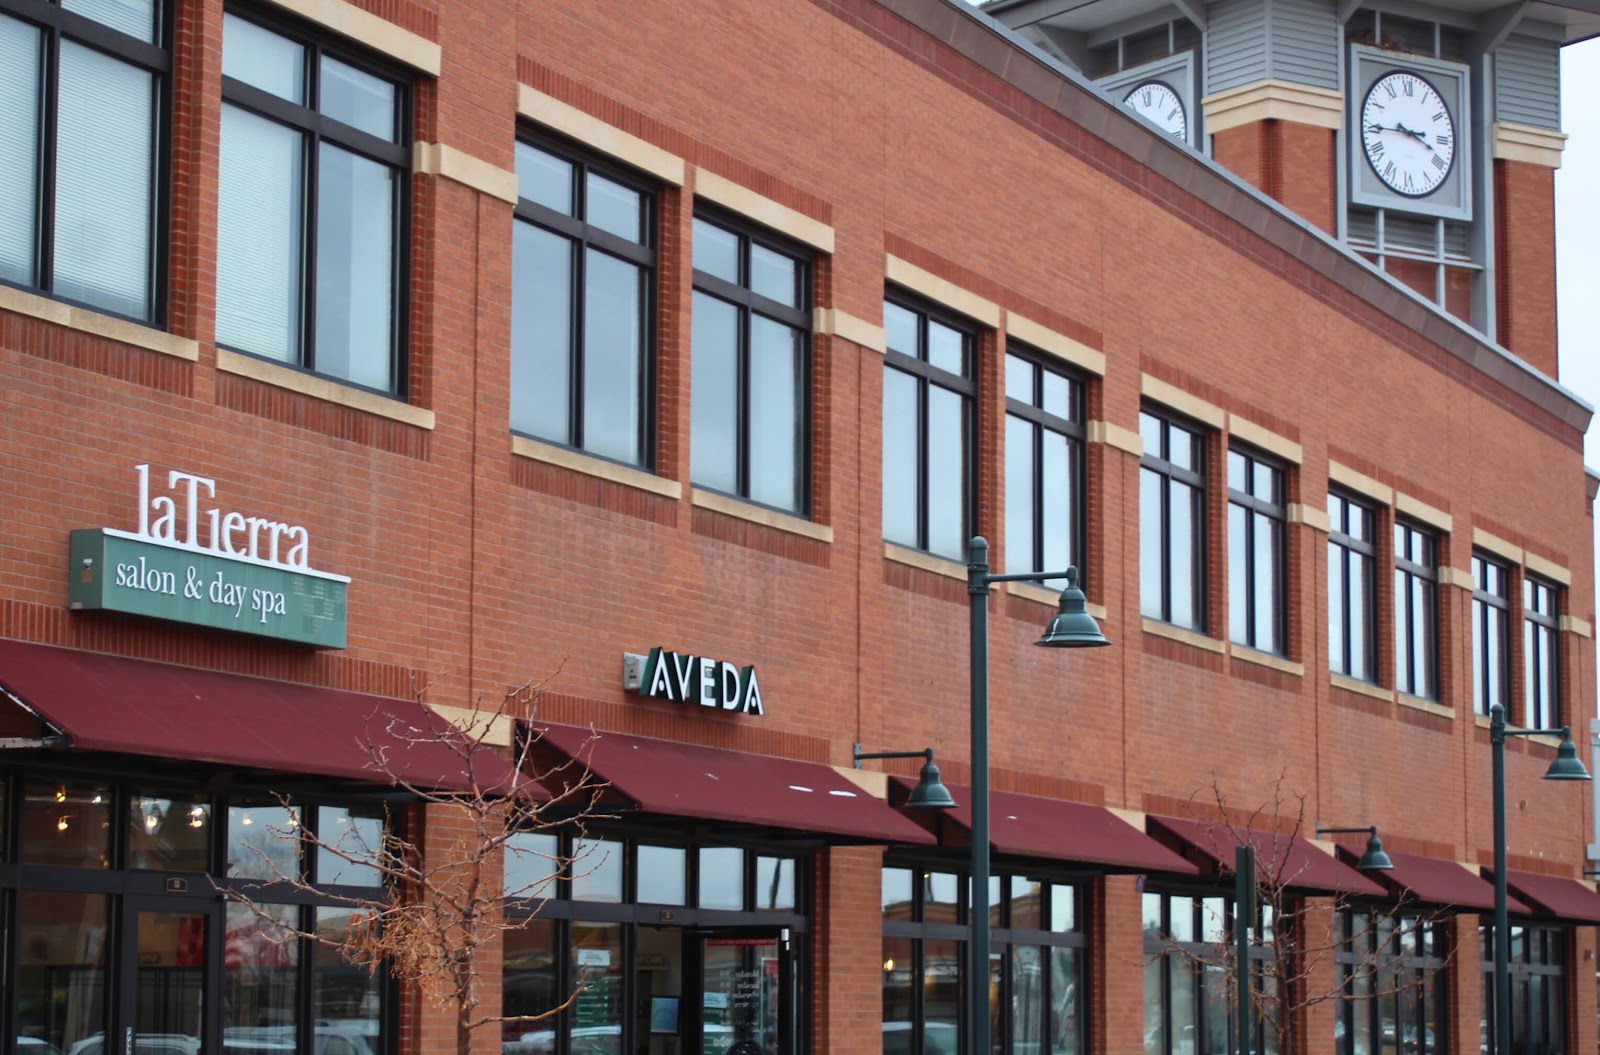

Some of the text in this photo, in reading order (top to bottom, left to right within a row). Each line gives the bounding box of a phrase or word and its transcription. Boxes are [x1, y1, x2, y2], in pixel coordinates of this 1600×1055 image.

[115, 556, 287, 624] salon & day spa
[645, 648, 765, 716] AVEDA
